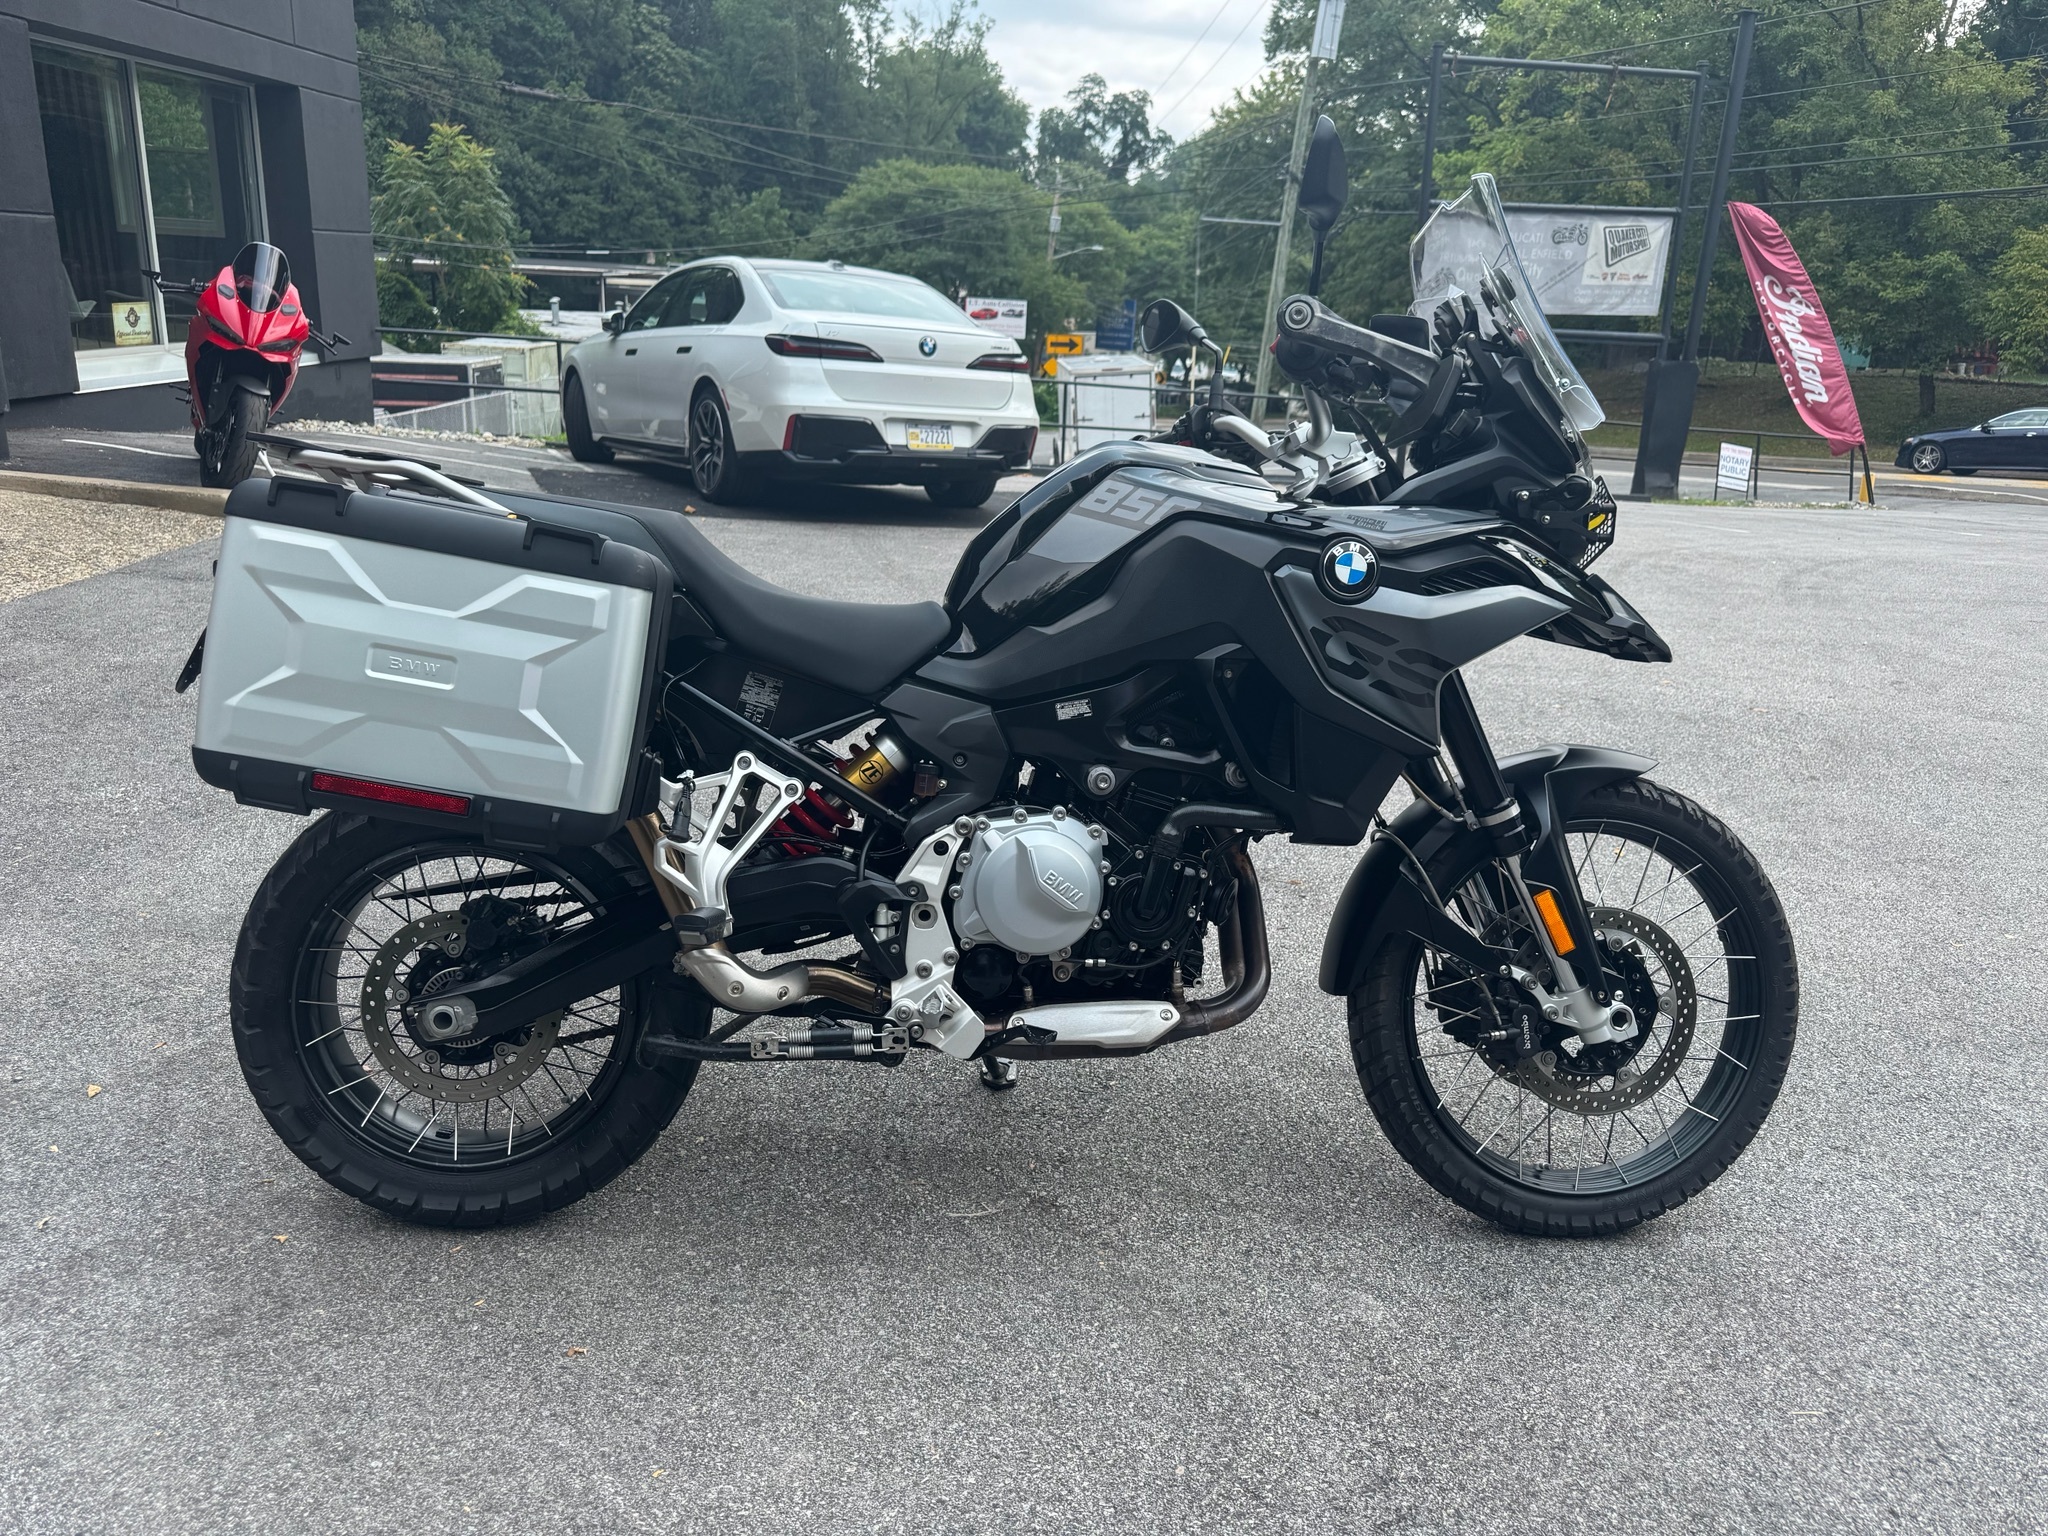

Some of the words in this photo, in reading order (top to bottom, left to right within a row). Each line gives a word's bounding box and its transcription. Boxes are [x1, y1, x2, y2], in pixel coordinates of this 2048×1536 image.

[1608, 228, 1637, 245] QUAKER
[1530, 248, 1573, 260] ENFIELD
[1755, 281, 1801, 405] MOTORCYCLE
[1763, 275, 1829, 405] Indian
[1720, 454, 1749, 467] NOTARY
[1720, 464, 1747, 476] PUBLIC
[1332, 541, 1376, 564] BMW
[388, 655, 440, 677] BMW
[860, 760, 884, 784] ZF
[1043, 869, 1084, 905] BMW
[1521, 1014, 1531, 1050] brembo
